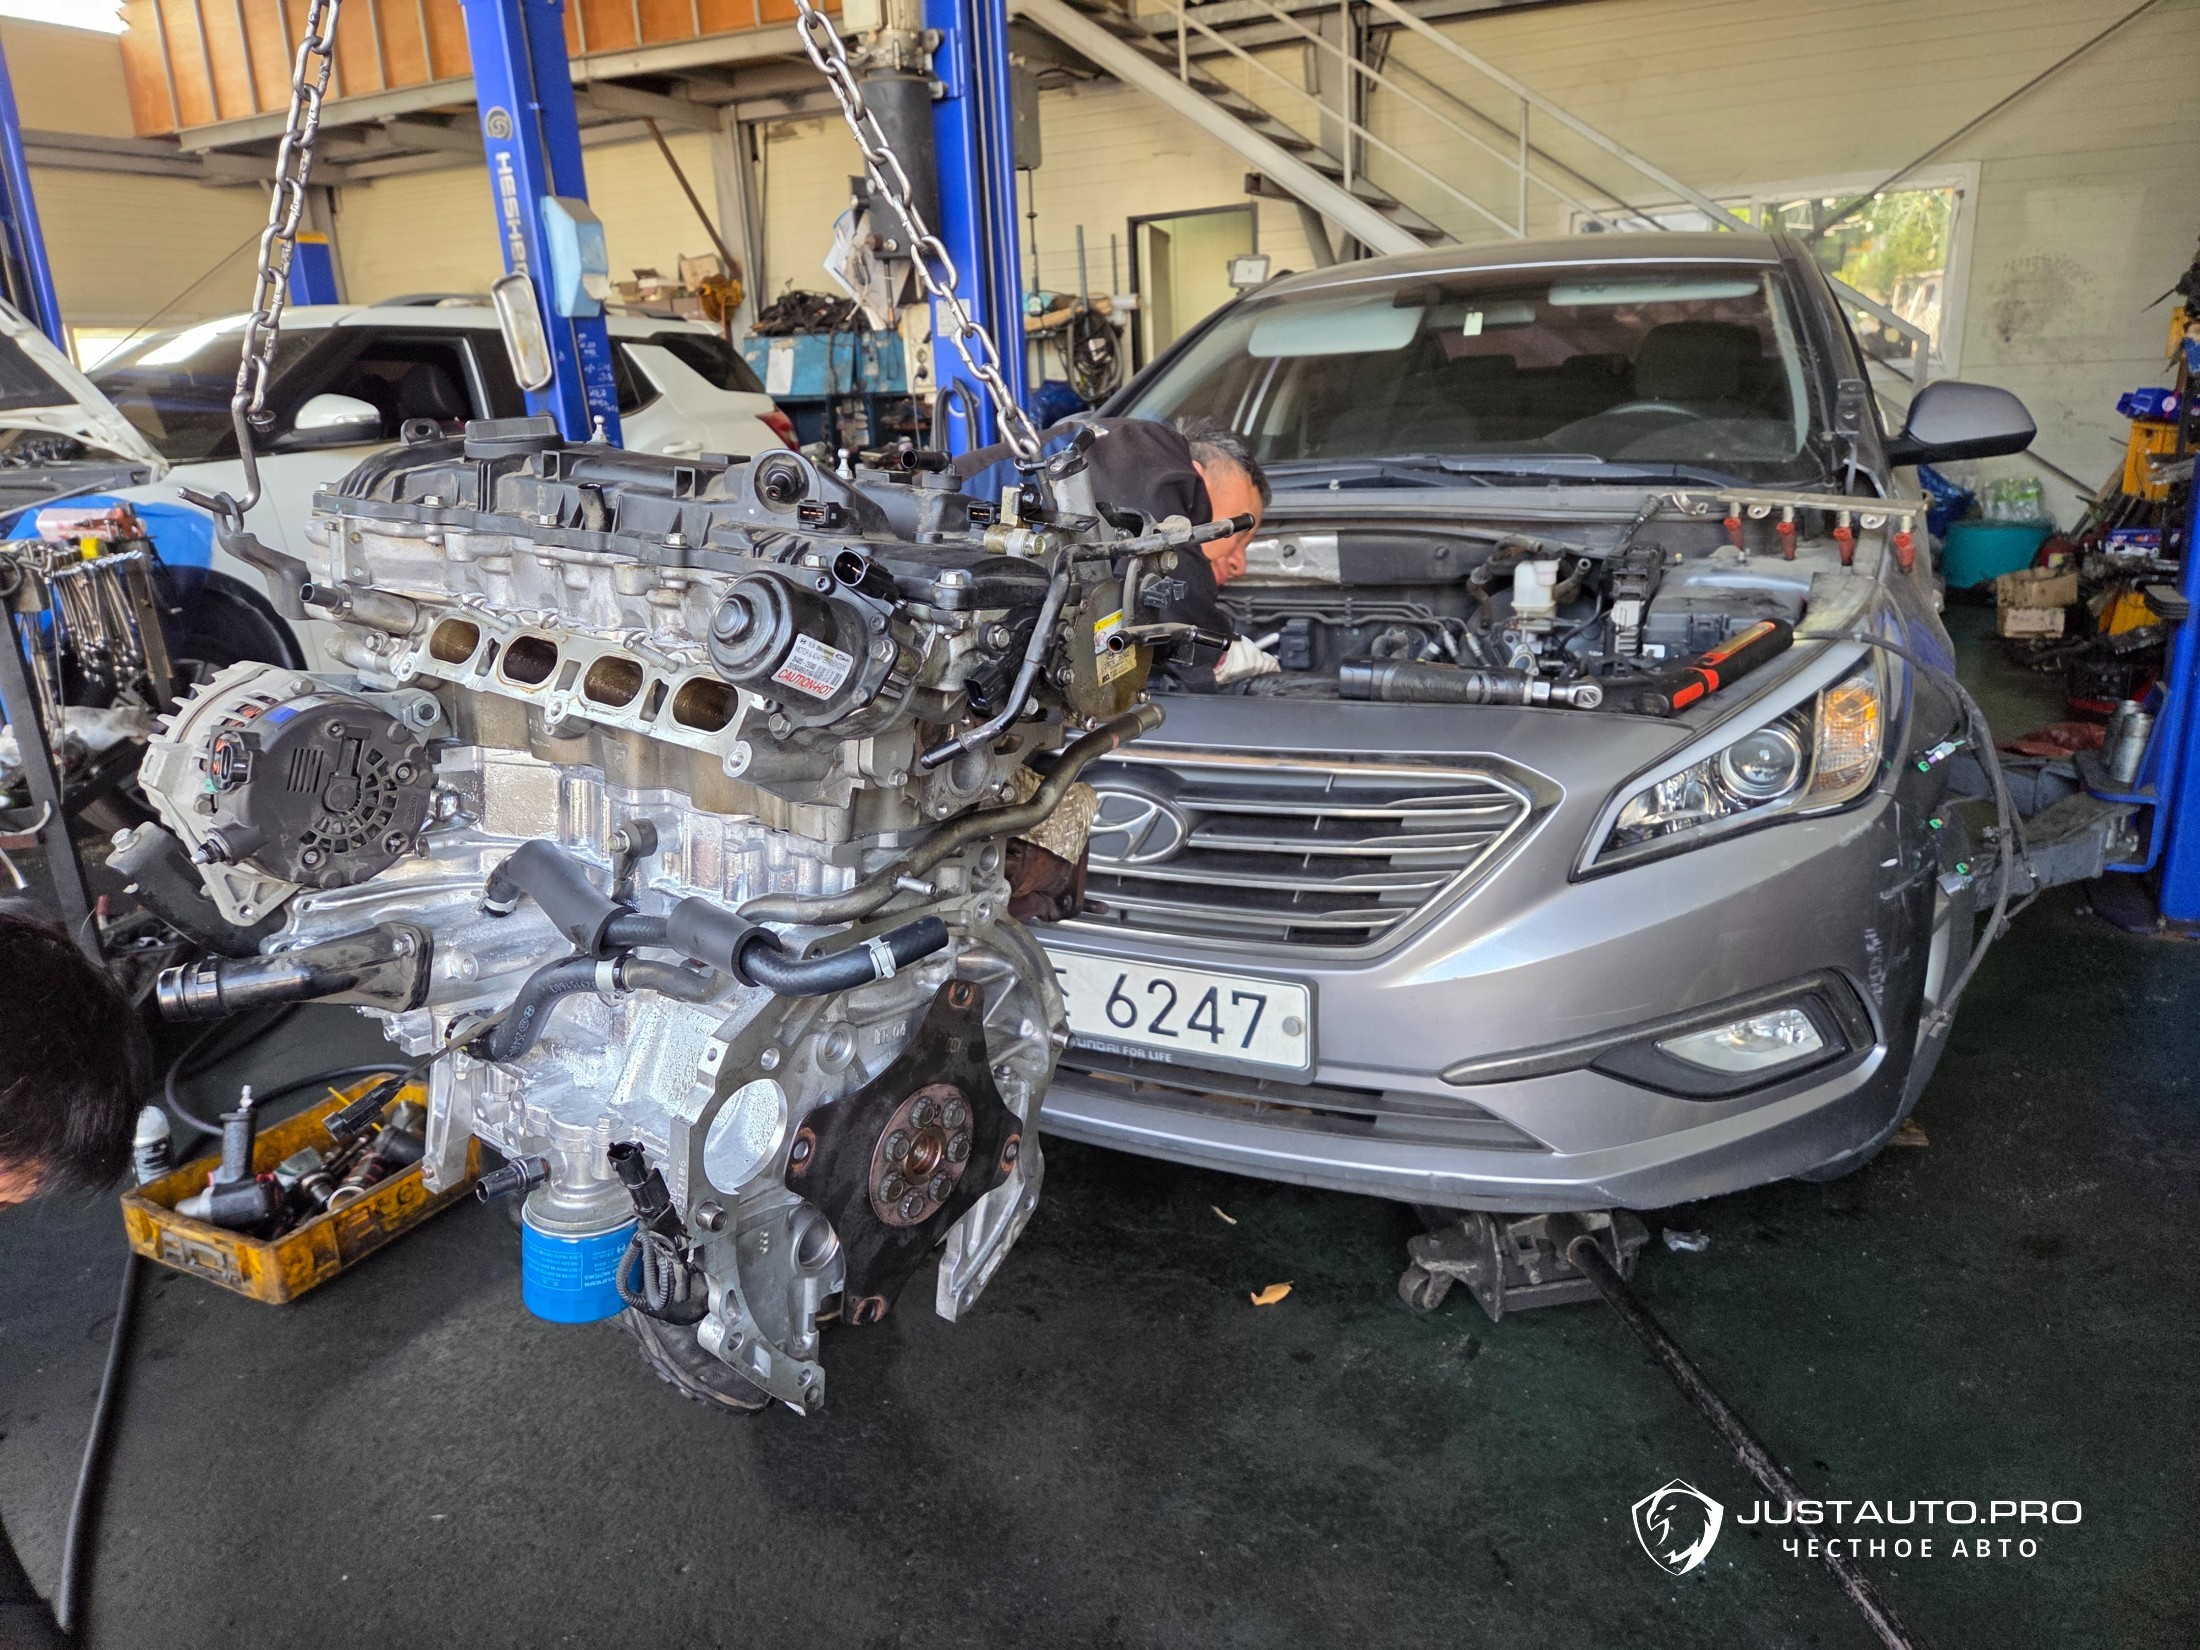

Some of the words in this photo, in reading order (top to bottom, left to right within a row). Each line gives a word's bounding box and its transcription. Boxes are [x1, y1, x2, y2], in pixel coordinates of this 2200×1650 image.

[495, 151, 529, 275] HESHBO
[778, 669, 835, 695] CAUTION-HOT
[1105, 973, 1268, 1049] 6247
[1076, 1038, 1120, 1055] UNDAI
[1123, 1046, 1146, 1060] FOR
[1149, 1050, 1173, 1064] LIFE
[584, 1276, 616, 1287] YUNDAI
